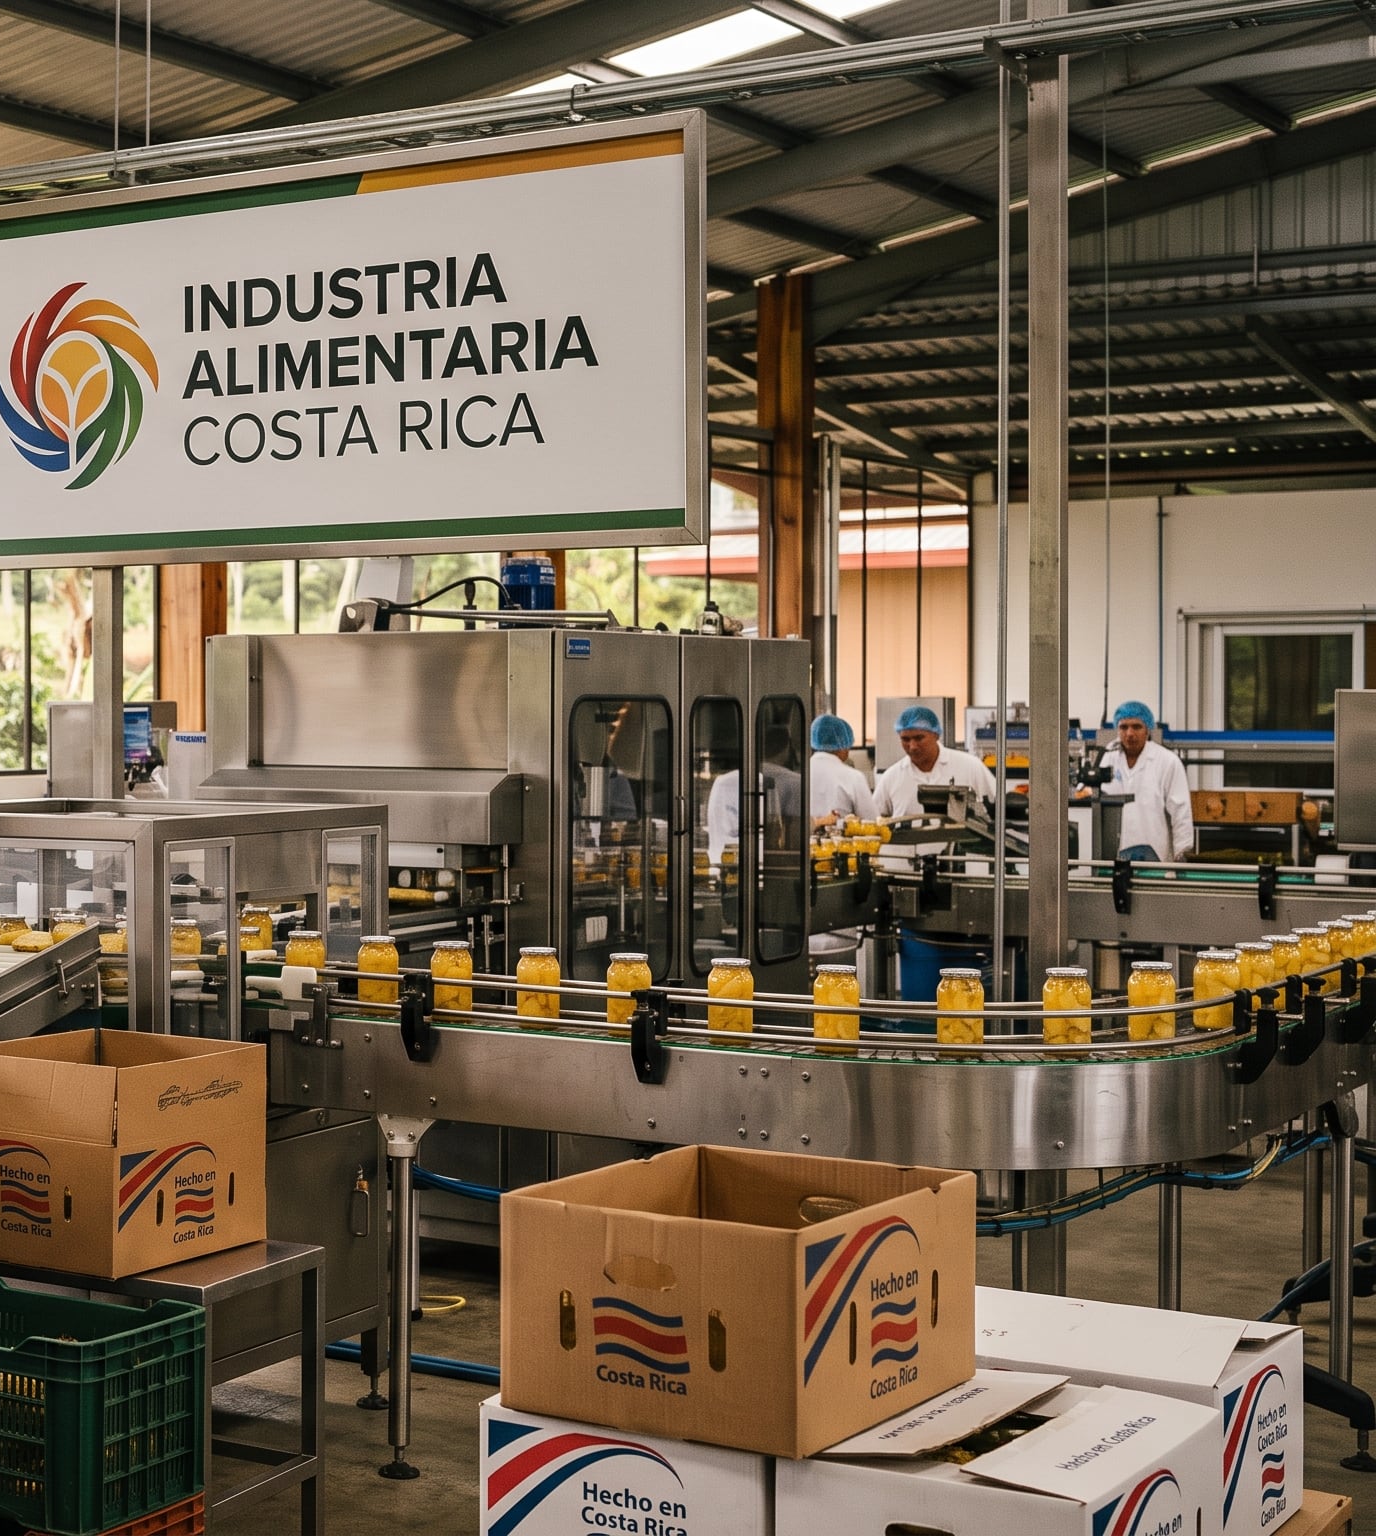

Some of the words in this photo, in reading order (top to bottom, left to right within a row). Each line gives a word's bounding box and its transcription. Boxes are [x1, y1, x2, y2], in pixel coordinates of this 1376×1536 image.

[184, 252, 508, 334] INDUSTRIA
[181, 315, 600, 400] ALIMENTARIA
[183, 404, 379, 466] COSTA
[399, 392, 546, 453] RICA
[0, 1164, 34, 1182] Hecho
[36, 1173, 51, 1185] en
[174, 1171, 204, 1190] Hecho
[205, 1170, 216, 1182] en
[31, 1223, 52, 1238] Rica
[173, 1230, 195, 1244] Costa
[197, 1224, 214, 1238] Rica
[870, 1271, 904, 1302] Hecho
[905, 1268, 919, 1289] en
[596, 1364, 646, 1389] Costa
[649, 1372, 688, 1396] Rica
[870, 1378, 897, 1400] Costa
[899, 1364, 918, 1388] Rica
[583, 1481, 653, 1513] Hecho
[659, 1500, 687, 1519] en
[581, 1505, 638, 1534] Costa
[1172, 1513, 1182, 1534] en
